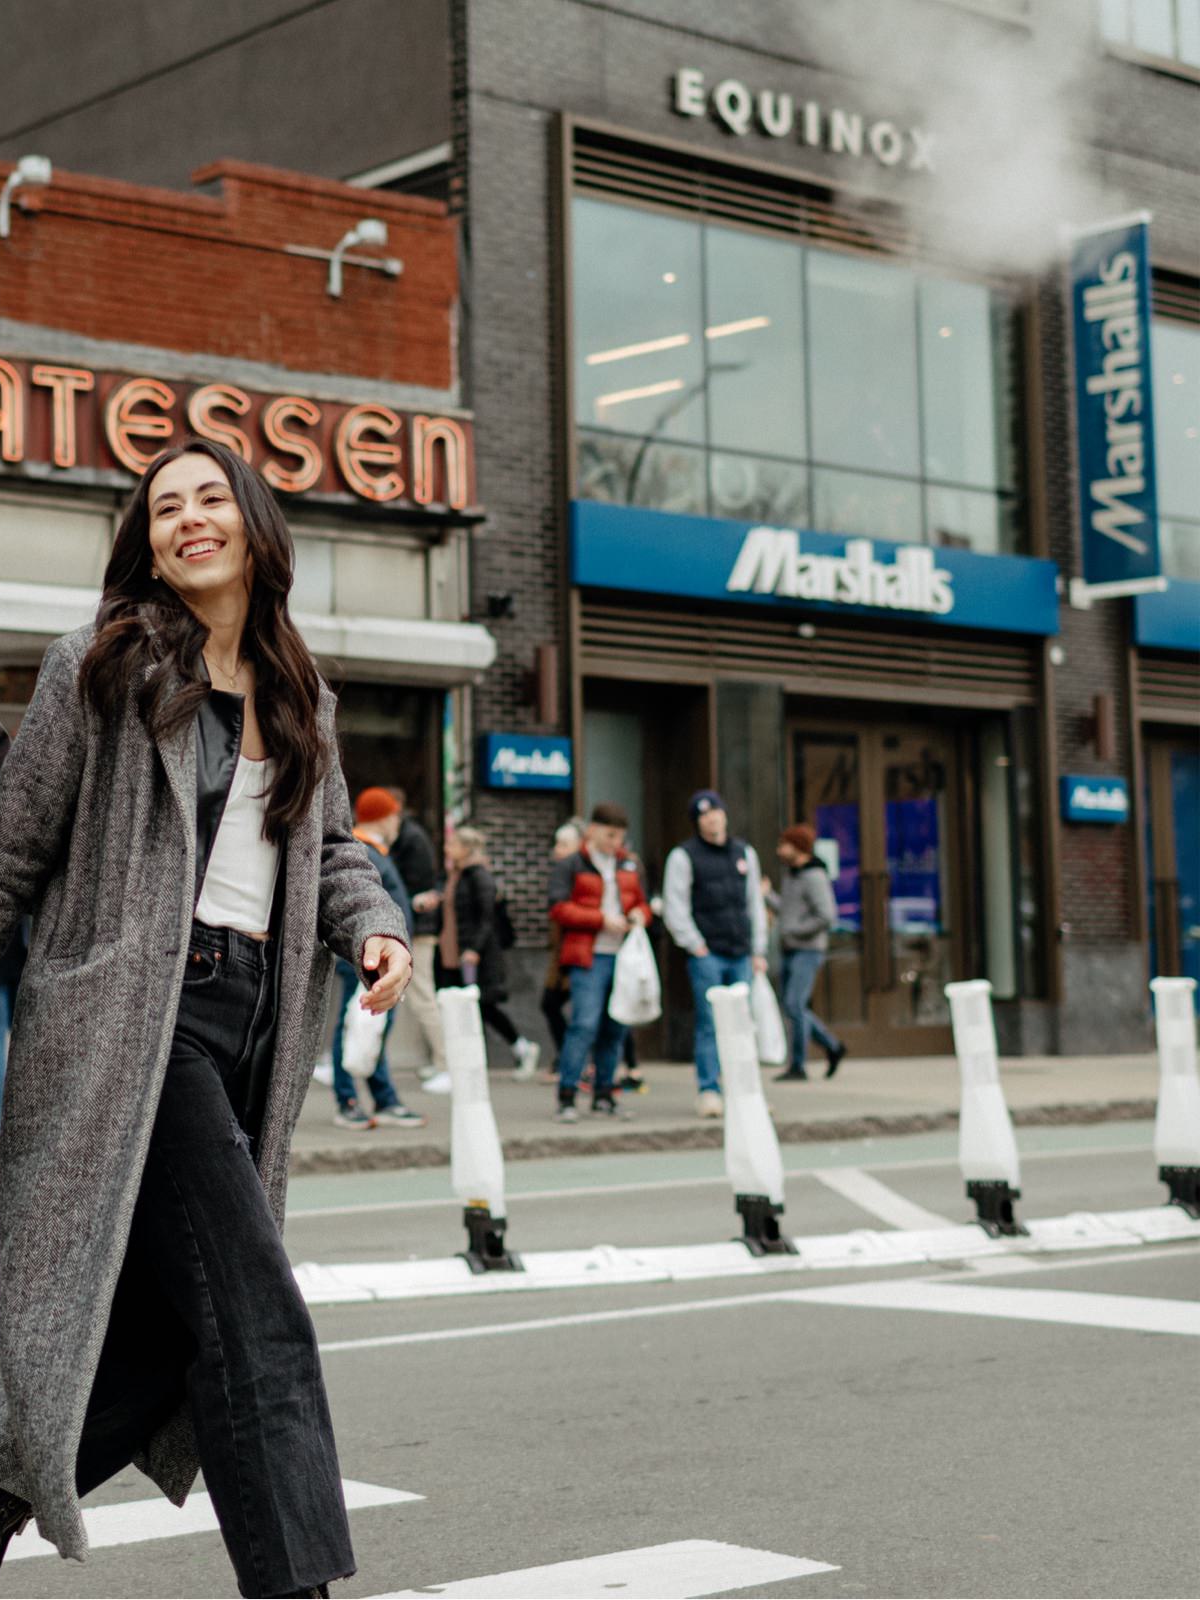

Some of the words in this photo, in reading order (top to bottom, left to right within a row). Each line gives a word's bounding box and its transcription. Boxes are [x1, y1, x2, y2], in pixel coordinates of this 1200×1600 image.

[676, 67, 934, 170] EQUINOX
[1083, 250, 1149, 557] Marshalls
[725, 525, 955, 616] Marshalls
